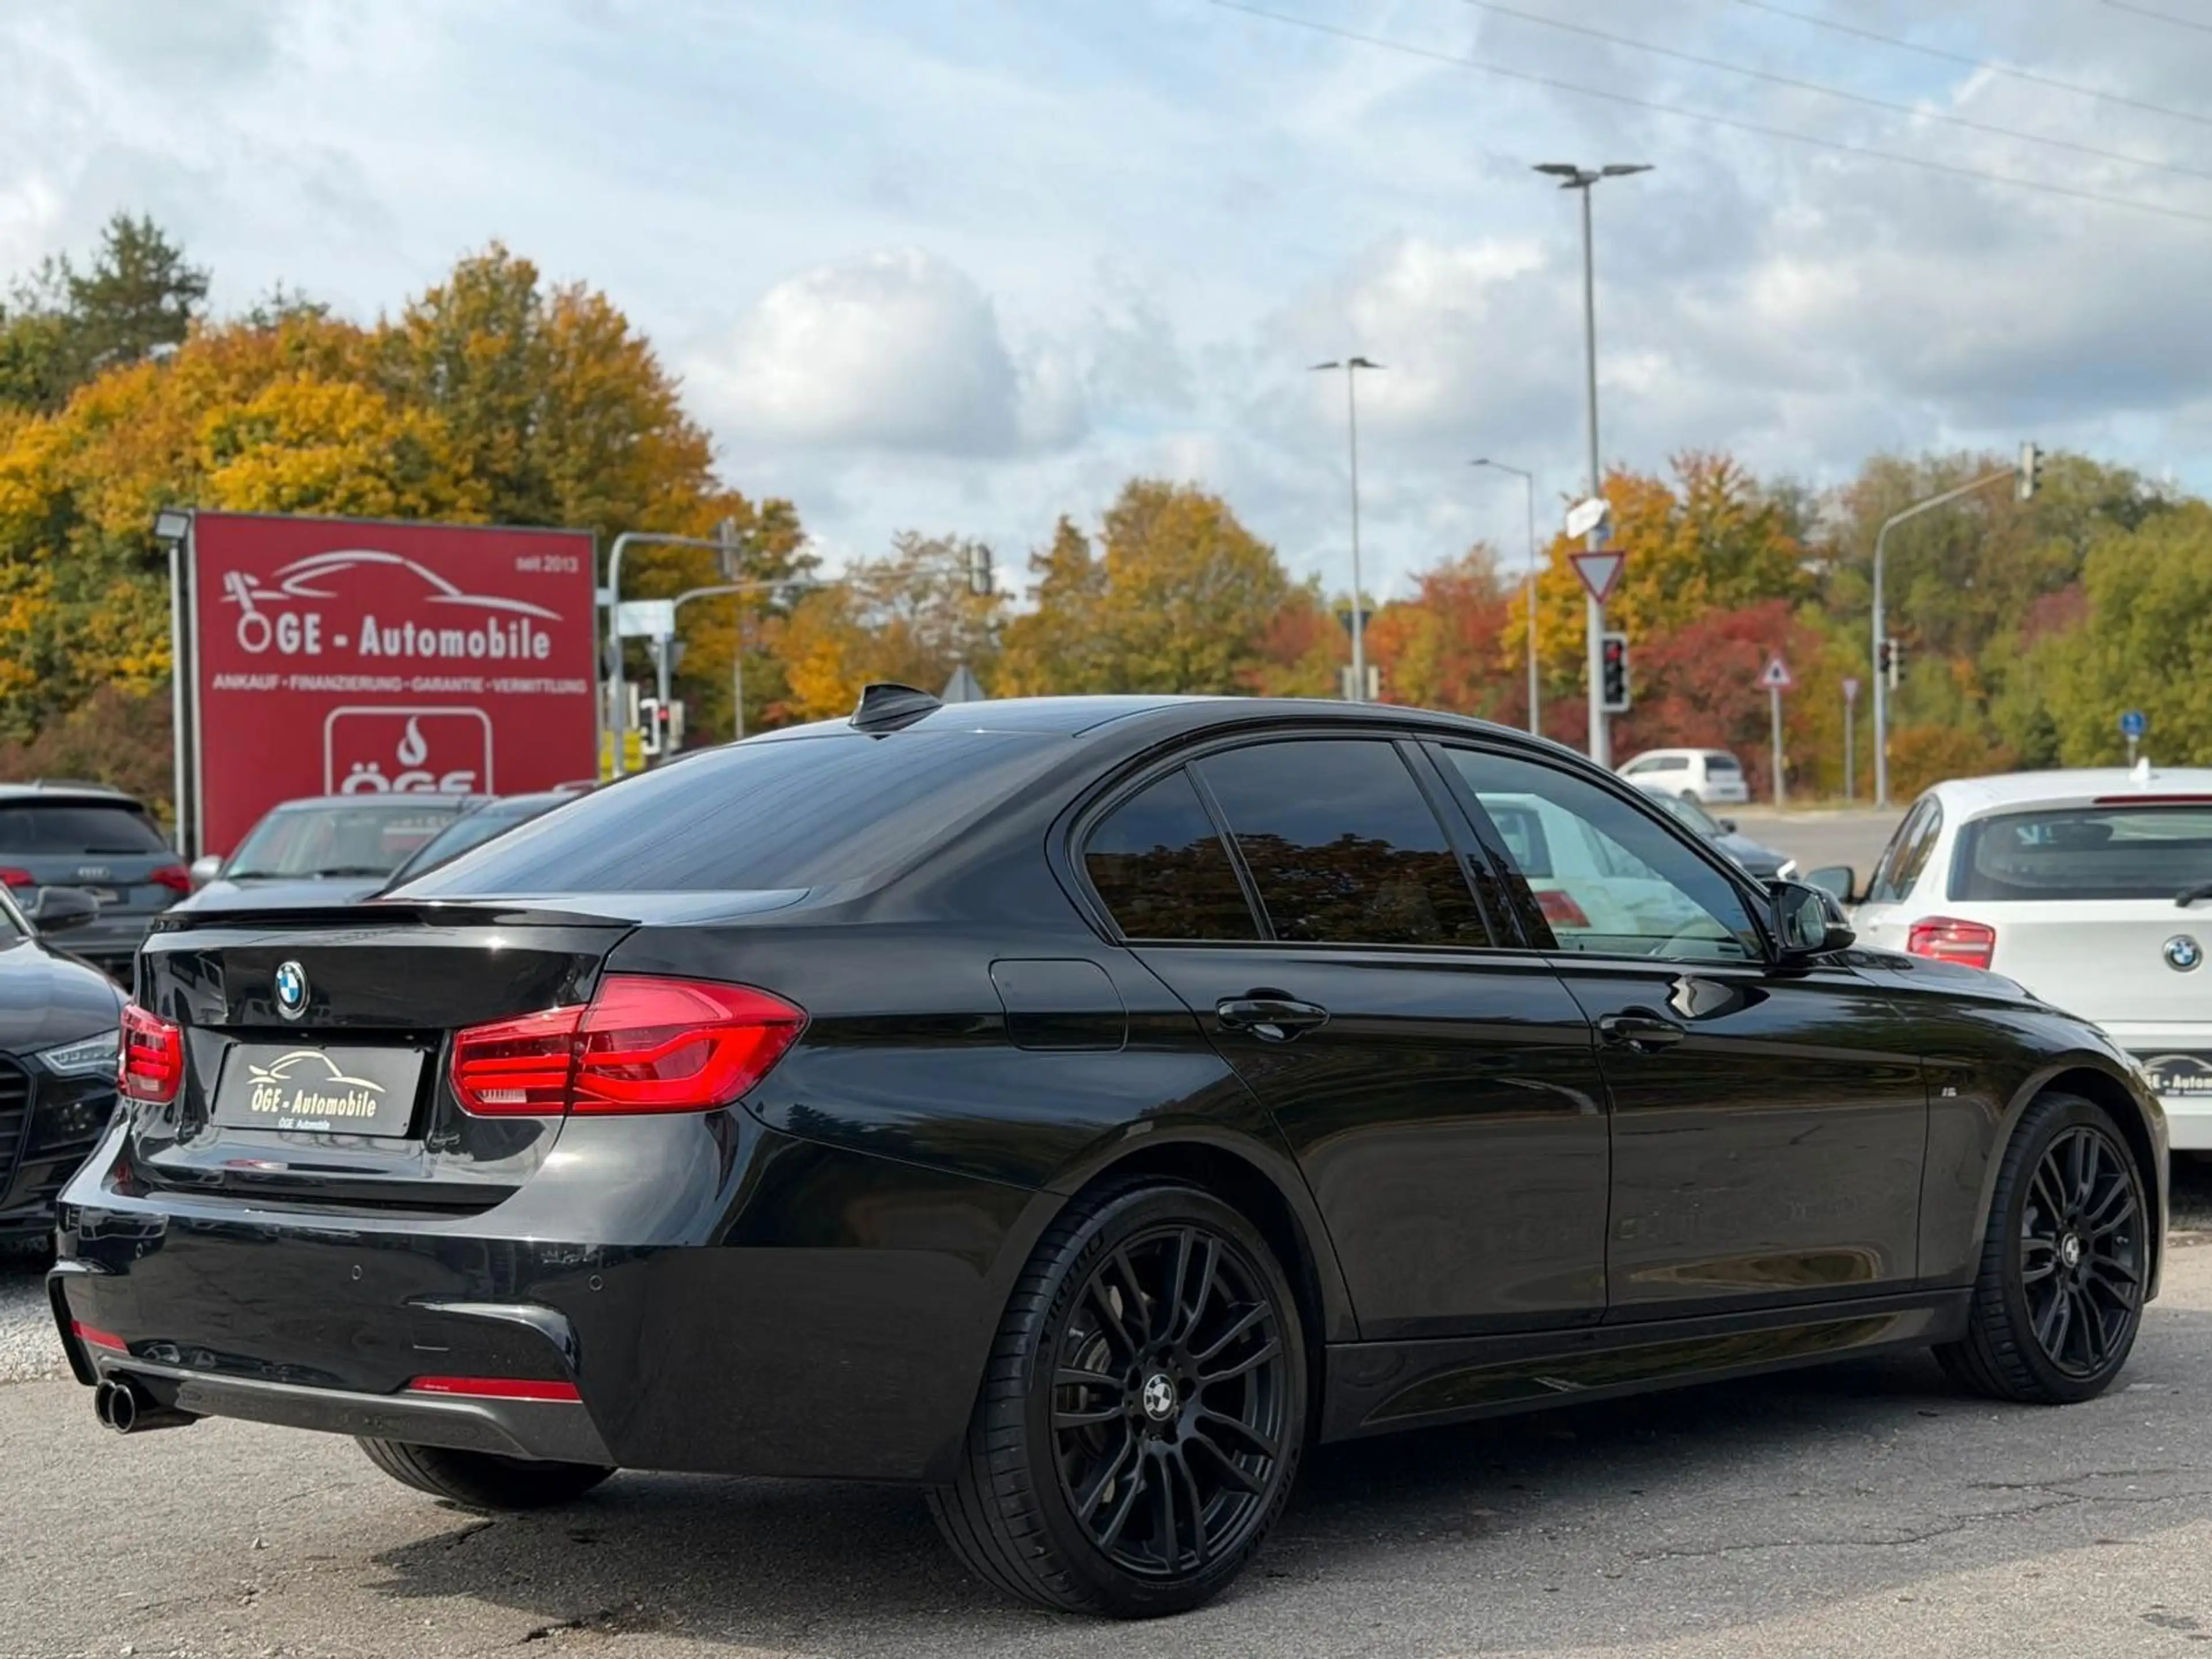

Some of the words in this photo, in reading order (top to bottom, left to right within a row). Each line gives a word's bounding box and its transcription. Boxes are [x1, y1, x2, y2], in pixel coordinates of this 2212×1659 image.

[359, 615, 551, 659] Automobile
[213, 673, 279, 691] ANKAUF
[289, 675, 403, 692] FINANZIERUNG
[411, 676, 484, 692] GARANTIE
[493, 677, 588, 694] VERMITTLUNG
[291, 1089, 376, 1117] Automobile
